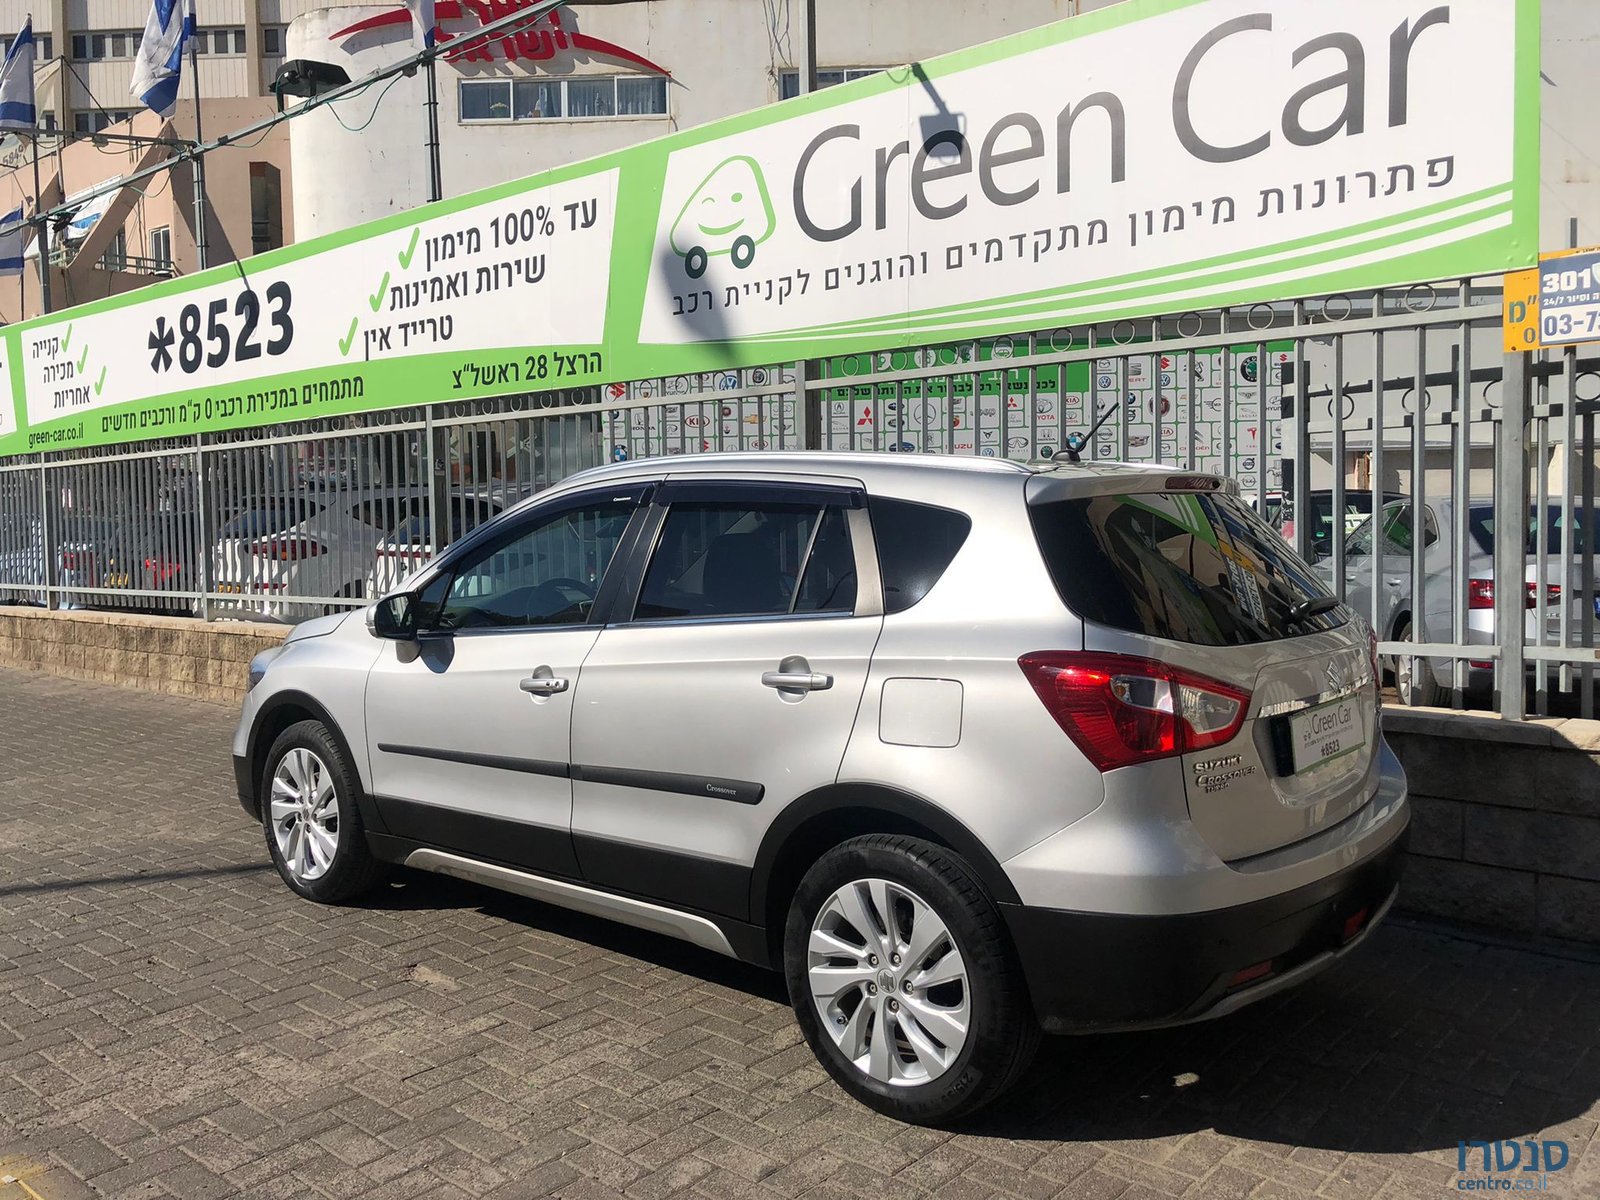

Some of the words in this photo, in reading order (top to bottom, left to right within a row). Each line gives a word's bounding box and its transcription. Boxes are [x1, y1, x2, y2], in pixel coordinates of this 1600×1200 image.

[793, 91, 1126, 242] Green
[1172, 5, 1450, 164] Car
[1257, 155, 1455, 217] פתרונות
[490, 205, 555, 249] 100%
[563, 198, 598, 232] עד
[1128, 194, 1236, 247] מימון
[425, 227, 481, 272] מימון
[945, 218, 1109, 270] מתקדמים
[475, 254, 546, 294] שירות
[824, 250, 929, 291] והוגנים
[1543, 267, 1592, 293] 301
[389, 270, 468, 312] ואמינות
[724, 268, 811, 308] לקניית
[1543, 295, 1564, 306] 24/7
[672, 290, 714, 317] רכב
[398, 314, 453, 348] טרייד
[1544, 310, 1600, 337] 03-7
[32, 337, 59, 360] קנייה
[364, 325, 392, 361] אין
[43, 361, 74, 384] מכירה
[525, 354, 548, 381] 28
[553, 351, 602, 377] הרצל
[53, 385, 91, 409] אחריות
[246, 386, 298, 413] במכירת
[302, 375, 364, 405] מתמחים
[140, 406, 175, 428] ורכבים
[205, 398, 212, 420] 0
[215, 397, 243, 418] רכבי
[28, 422, 84, 449] green-car.co.il
[102, 412, 136, 433] חדשים
[1312, 712, 1338, 735] Green
[1338, 704, 1352, 725] Car
[1193, 754, 1242, 774] SUZUKI
[706, 783, 737, 796] Crossover
